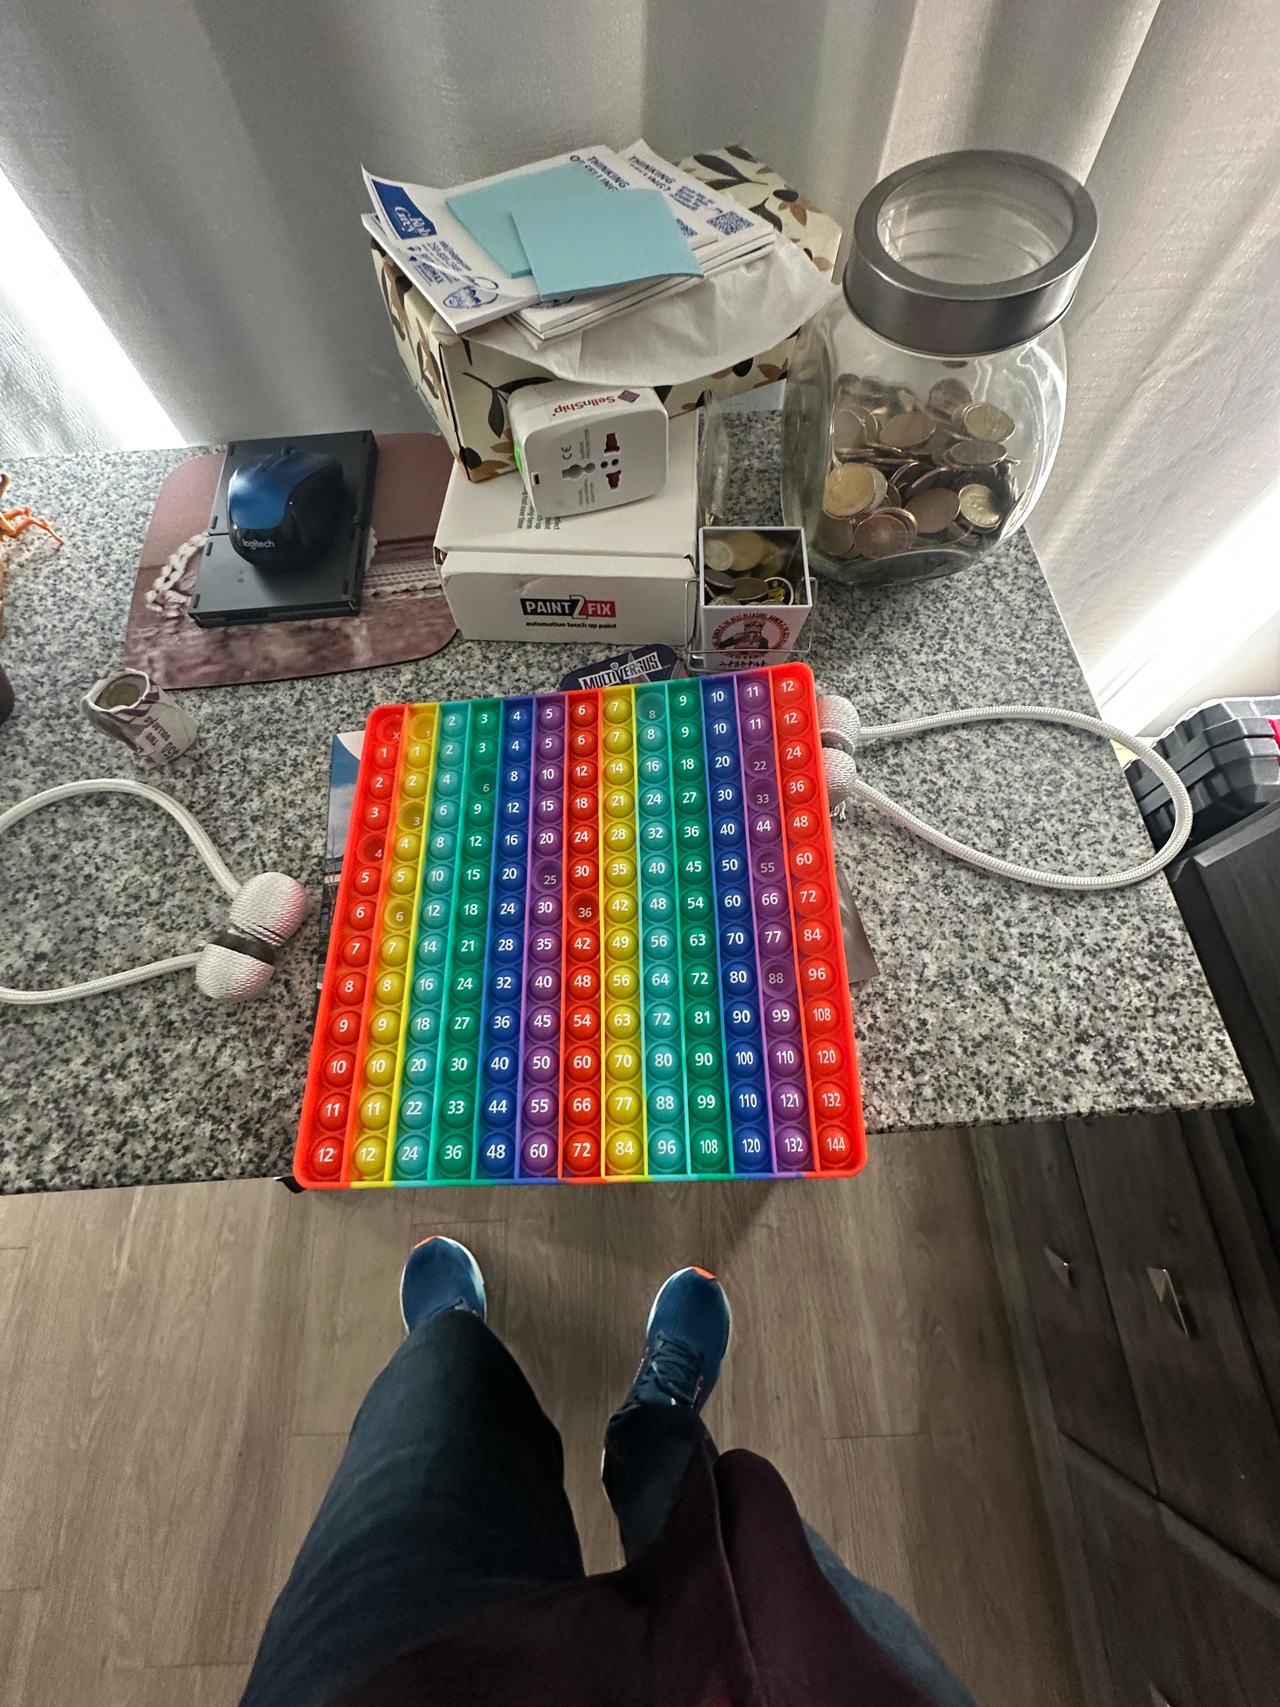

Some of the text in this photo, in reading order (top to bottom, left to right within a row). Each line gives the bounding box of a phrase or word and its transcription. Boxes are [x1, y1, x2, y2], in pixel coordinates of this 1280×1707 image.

[587, 156, 630, 189] THINKING
[628, 155, 675, 184] THINKING
[242, 538, 276, 551] logitech
[525, 620, 567, 628] automotive
[588, 622, 598, 630] up
[598, 622, 617, 630] paint
[448, 715, 456, 727] 2
[481, 713, 488, 724] 3
[546, 708, 553, 719] 5
[577, 704, 586, 716] 6
[612, 701, 620, 712] 7
[679, 695, 687, 707] 9
[711, 690, 725, 703] 10
[746, 685, 759, 698] 11
[381, 712, 798, 758] 1 1 3 4 5 7 8 9 11 12
[408, 755, 767, 793] 2 4 6 10 12 14 18 20 22
[370, 779, 805, 826] 3 3 9 12 15 21 24 27 33 36
[400, 819, 772, 849] 4 8 12 20 24 28 36 40 44
[361, 851, 813, 885] 5 5 15 20 25 35 40 45 55 60
[395, 892, 779, 922] 6 12 18 30 36 42 54 60 66
[351, 928, 822, 955] 7 7 21 28 35 49 56 63 77 84
[382, 970, 784, 992] 8 16 24 40 48 56 72 80 88
[339, 1007, 832, 1033] 9 9 27 36 45 63 72 81 99 108
[370, 1050, 795, 1073] 10 20 30 50 60 70 90 100 110
[325, 1092, 841, 1117] 11 11 33 44 55 77 88 99 121 132
[360, 1135, 804, 1162] 12 24 36 60 72 84 108 120 132
